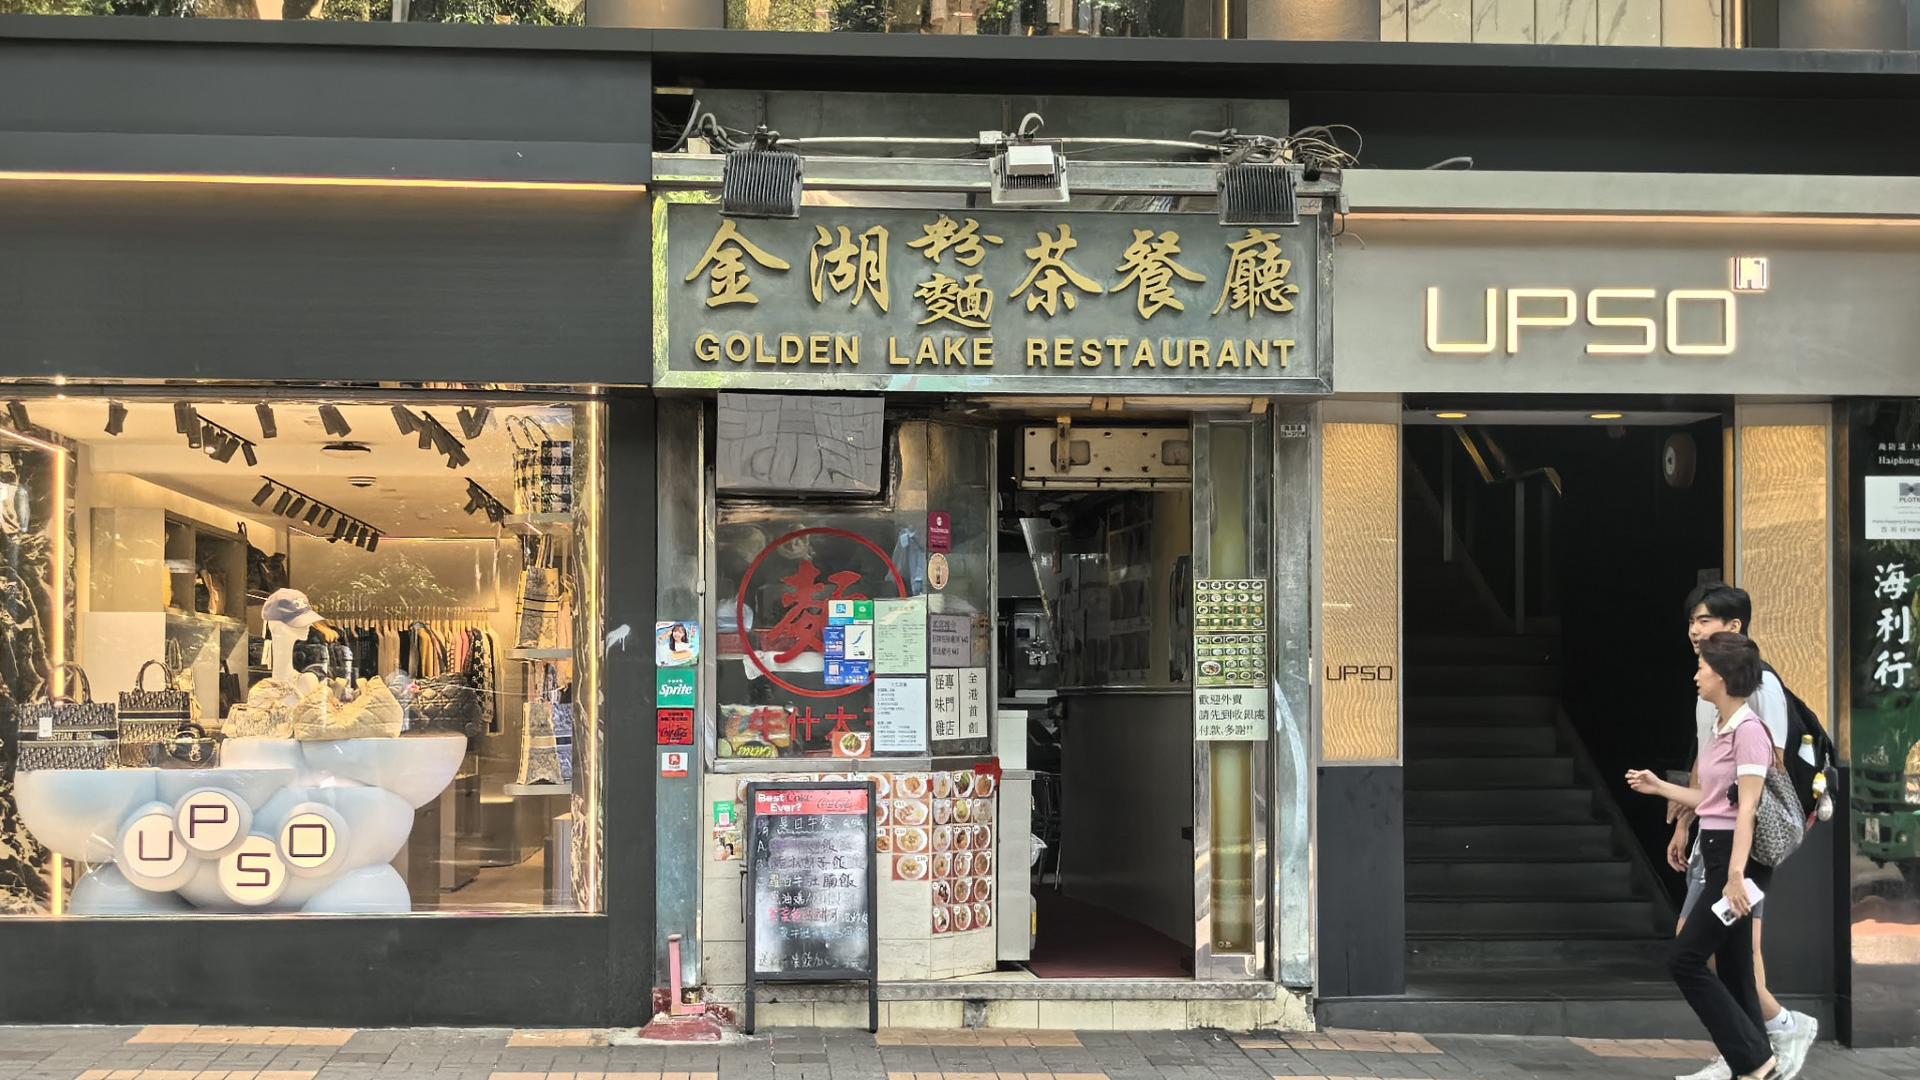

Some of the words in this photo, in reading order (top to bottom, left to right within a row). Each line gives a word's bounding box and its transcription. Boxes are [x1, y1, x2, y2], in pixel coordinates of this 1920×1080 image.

[1426, 286, 1736, 355] UPSO
[695, 334, 860, 366] GOLDEN
[889, 335, 994, 368] LAKE
[1026, 337, 1296, 369] RESTAURANT
[1873, 562, 1913, 689] 海利行
[1326, 665, 1393, 681] UPSO
[659, 683, 693, 697] Sprite
[758, 793, 785, 802] Best
[770, 803, 802, 812] Ever?
